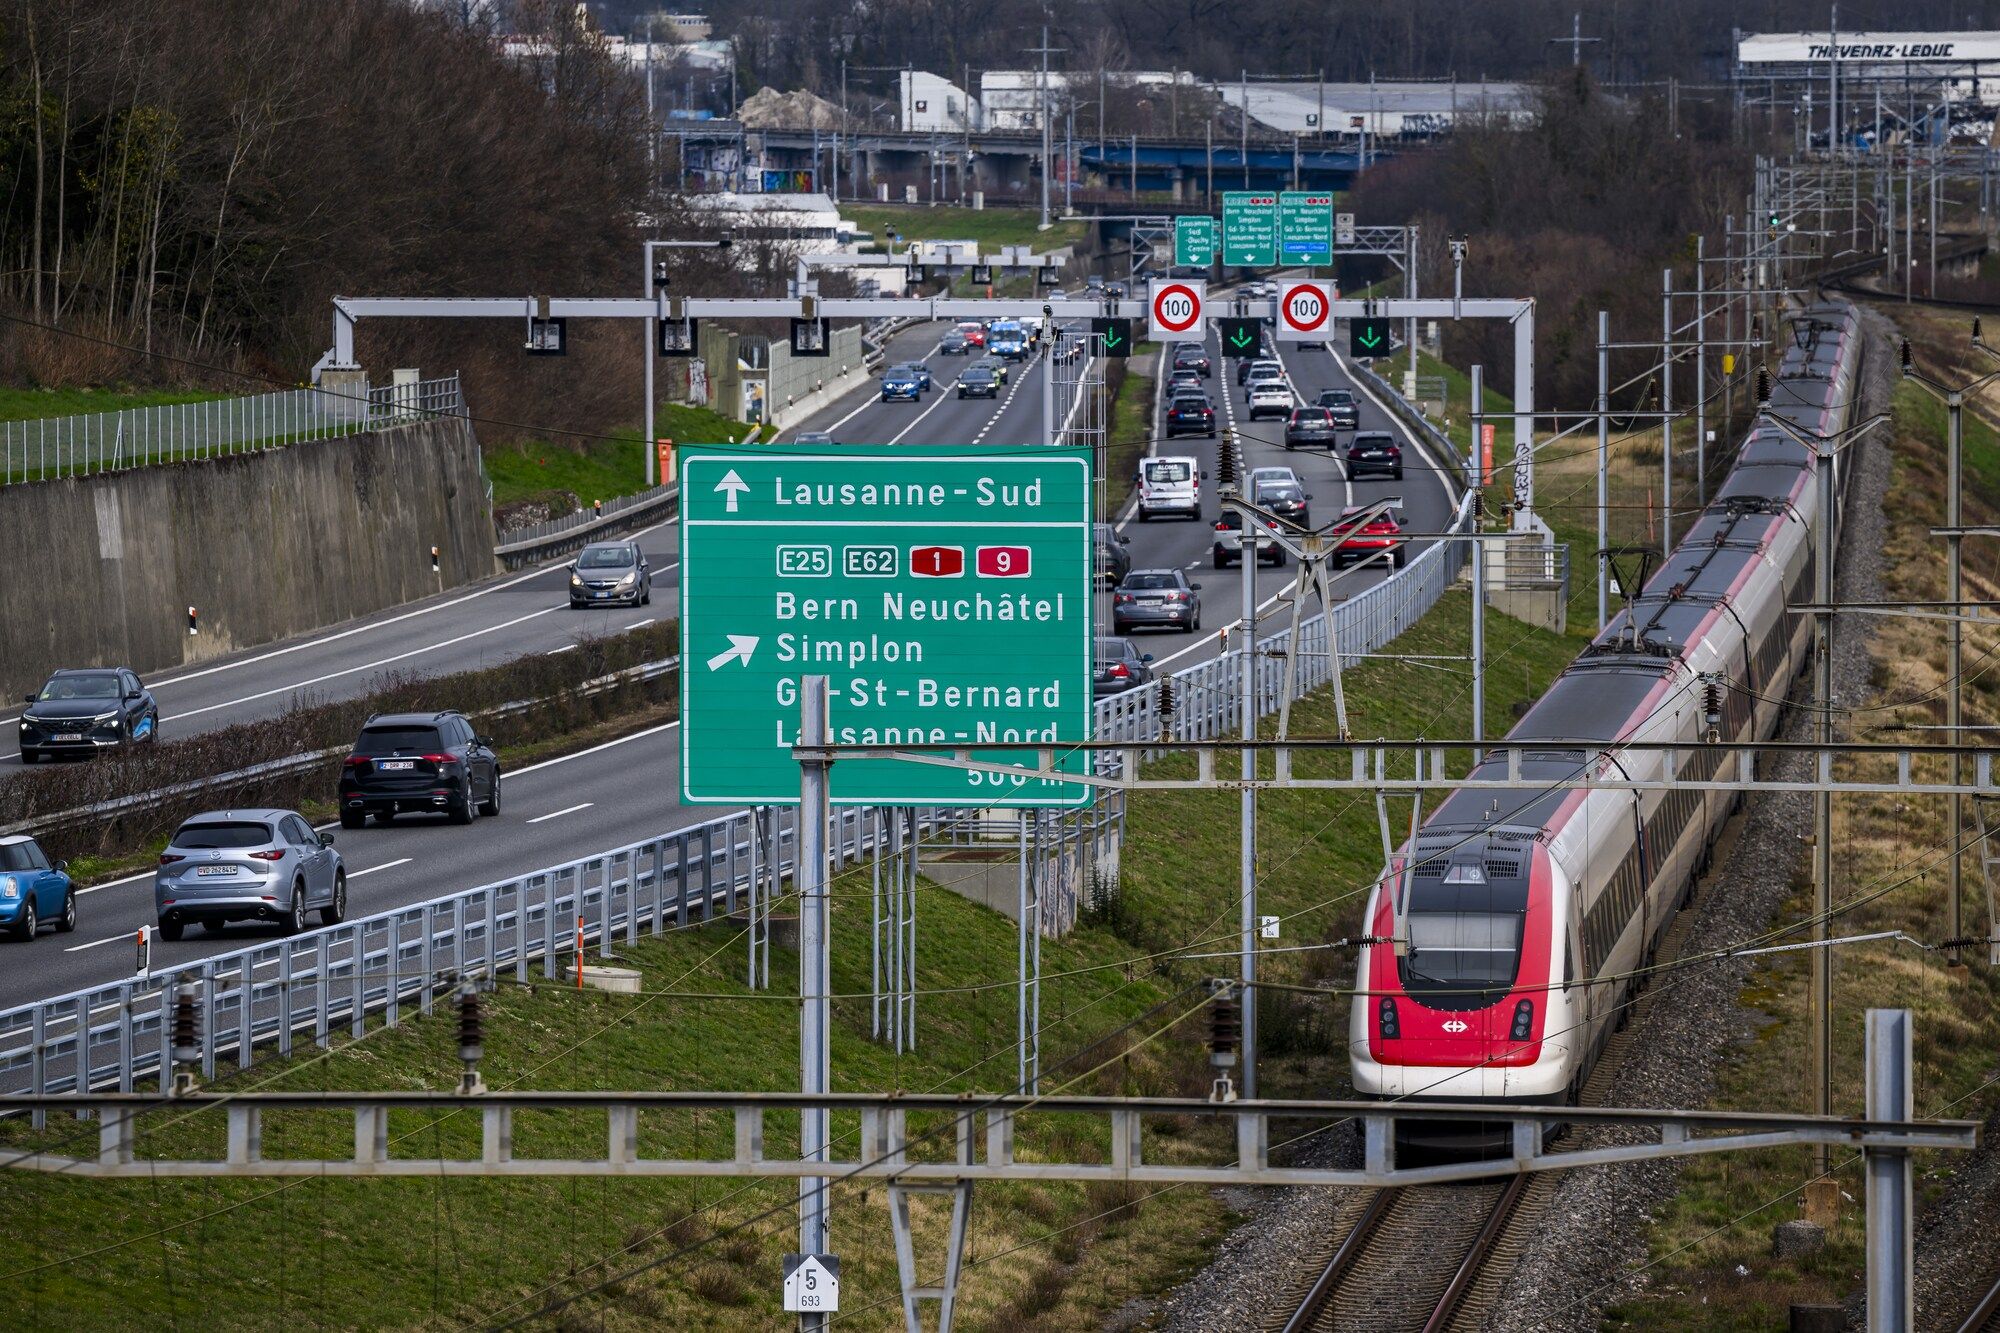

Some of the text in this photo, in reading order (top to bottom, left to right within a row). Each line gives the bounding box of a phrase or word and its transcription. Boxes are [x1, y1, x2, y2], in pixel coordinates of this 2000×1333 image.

[1163, 300, 1190, 317] 100
[1292, 300, 1319, 317] 100
[782, 550, 1011, 573] E25 E62 1 9
[776, 591, 1064, 621] Bern Neuchâtel
[776, 633, 923, 669] Simplon
[776, 677, 1060, 708] G-St-Bernard
[805, 1268, 817, 1290] 5
[801, 1295, 820, 1307] 693
